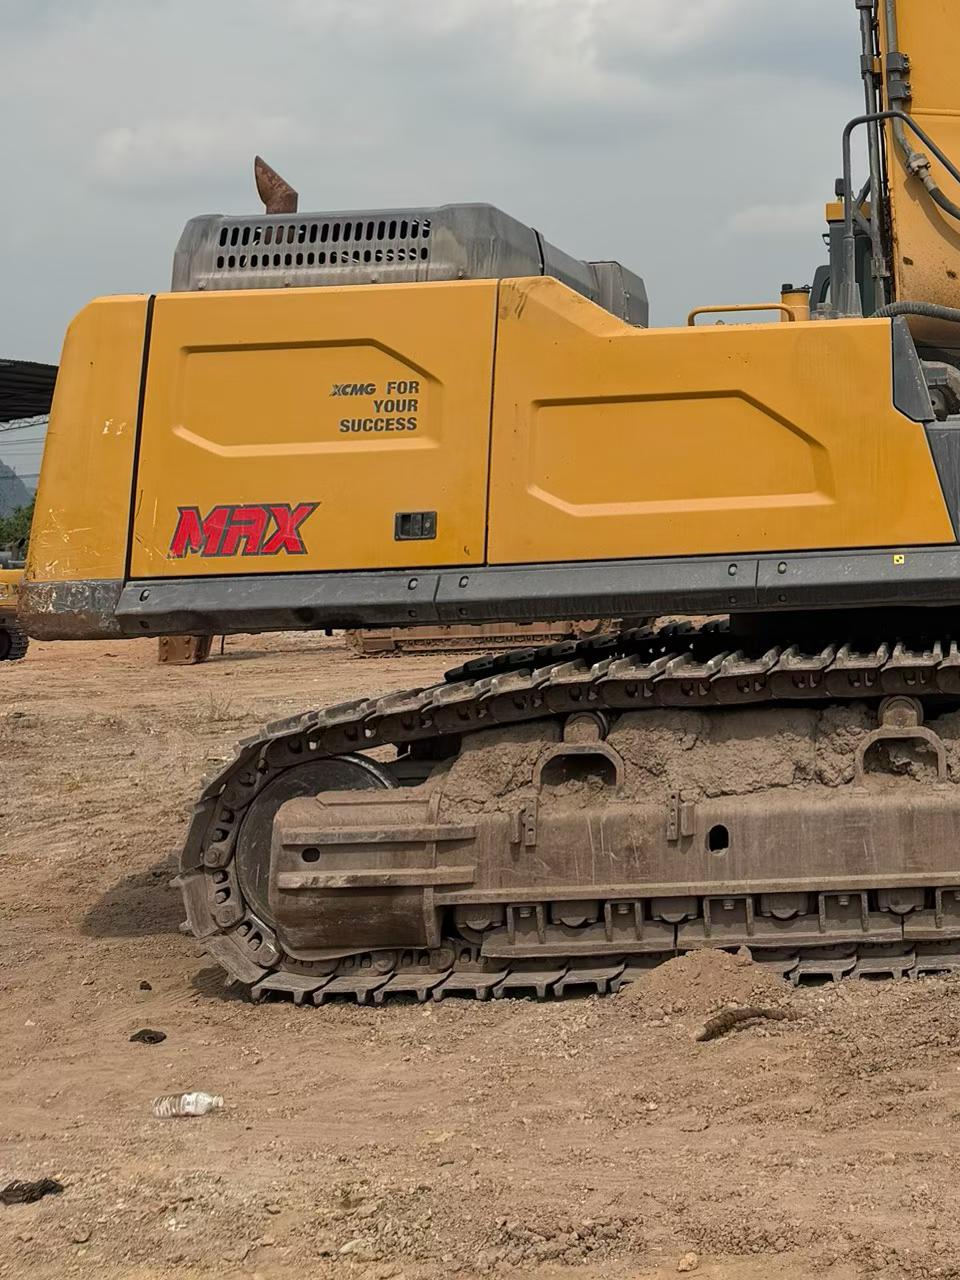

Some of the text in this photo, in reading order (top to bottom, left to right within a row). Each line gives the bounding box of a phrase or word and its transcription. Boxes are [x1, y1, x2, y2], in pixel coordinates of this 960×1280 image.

[329, 381, 420, 396] XCMG FOR
[373, 399, 419, 413] YOUR
[339, 417, 418, 433] SUCCESS
[166, 502, 322, 559] MAX
